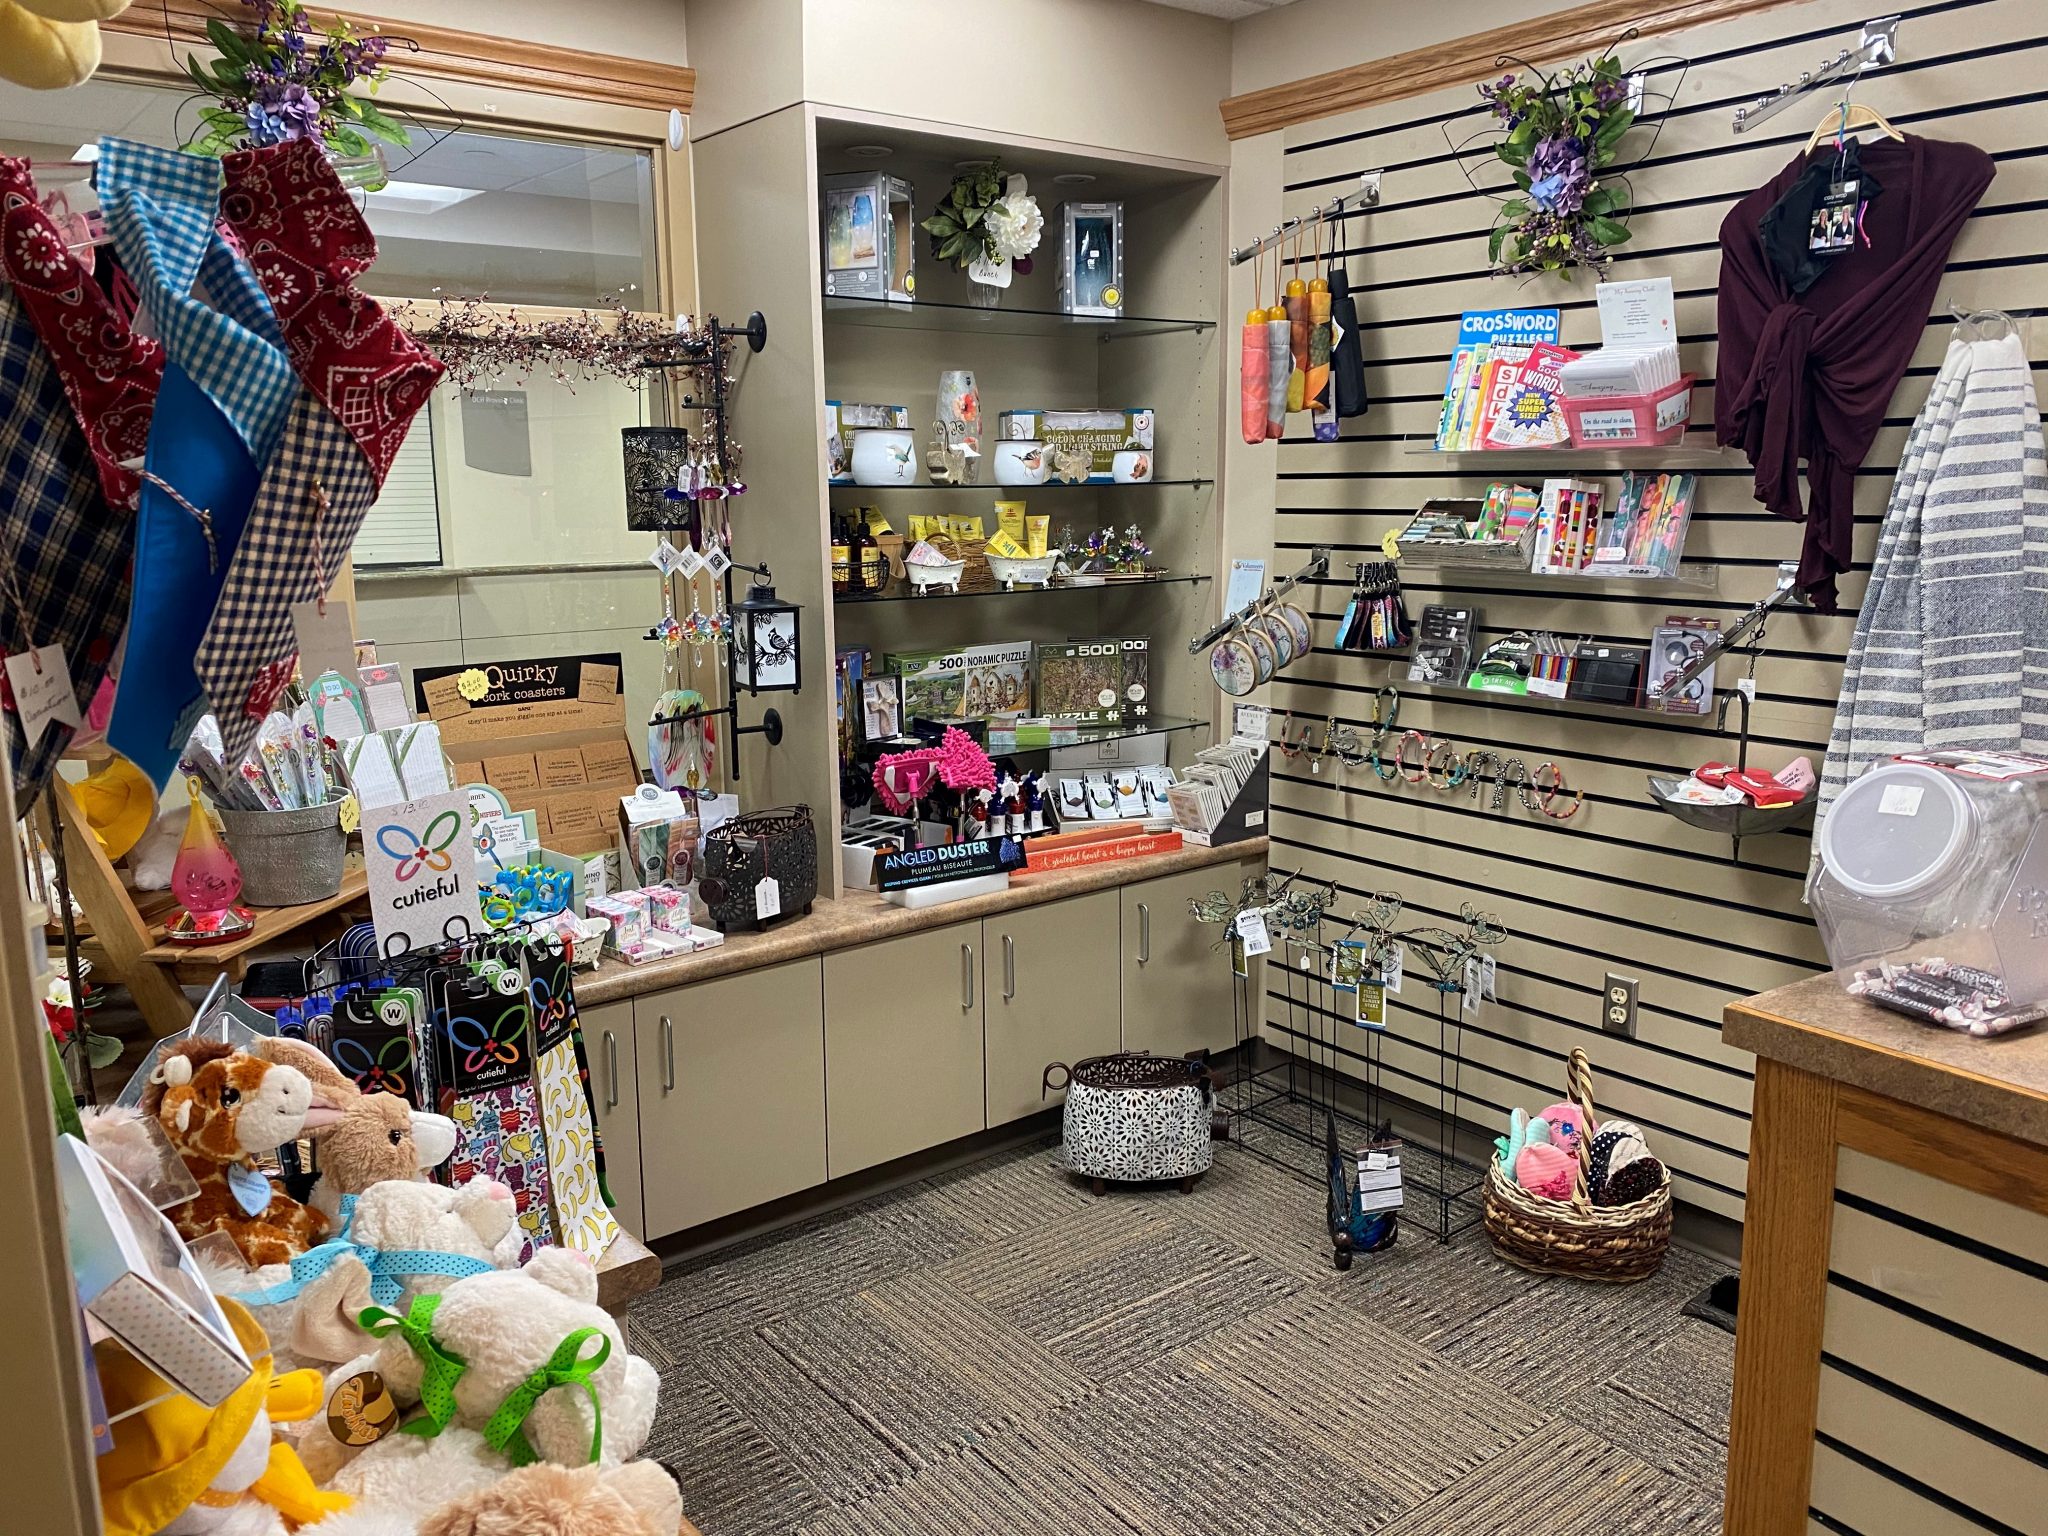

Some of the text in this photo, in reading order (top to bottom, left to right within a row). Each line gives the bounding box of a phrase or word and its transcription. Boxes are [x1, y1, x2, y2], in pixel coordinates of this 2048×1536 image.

[1462, 312, 1557, 333] CROSSWORD
[1491, 333, 1543, 344] PUZZLES
[1514, 404, 1547, 412] JUMBO
[1519, 411, 1540, 419] SIZE!
[1046, 434, 1122, 444] COLOR CHANGING
[1090, 442, 1124, 451] STRING
[1078, 644, 1115, 656] 500
[938, 657, 964, 670] 500
[1001, 650, 1027, 663] PUZZLE
[484, 665, 559, 689] Quirky
[482, 690, 511, 703] cork
[514, 684, 566, 700] coasters
[488, 715, 505, 724] make
[505, 714, 517, 723] you
[517, 713, 535, 722] giggle
[884, 840, 989, 869] ANGLED DUSTER
[1052, 853, 1080, 866] grateful
[1082, 850, 1100, 861] heart
[1102, 849, 1108, 857] is
[1116, 843, 1136, 856] happy
[1137, 840, 1157, 852] heart
[911, 864, 941, 875] PLUMEAU
[392, 873, 460, 910] cutieful
[503, 978, 517, 988] W
[387, 1008, 401, 1018] W
[476, 1065, 507, 1080] cutieful
